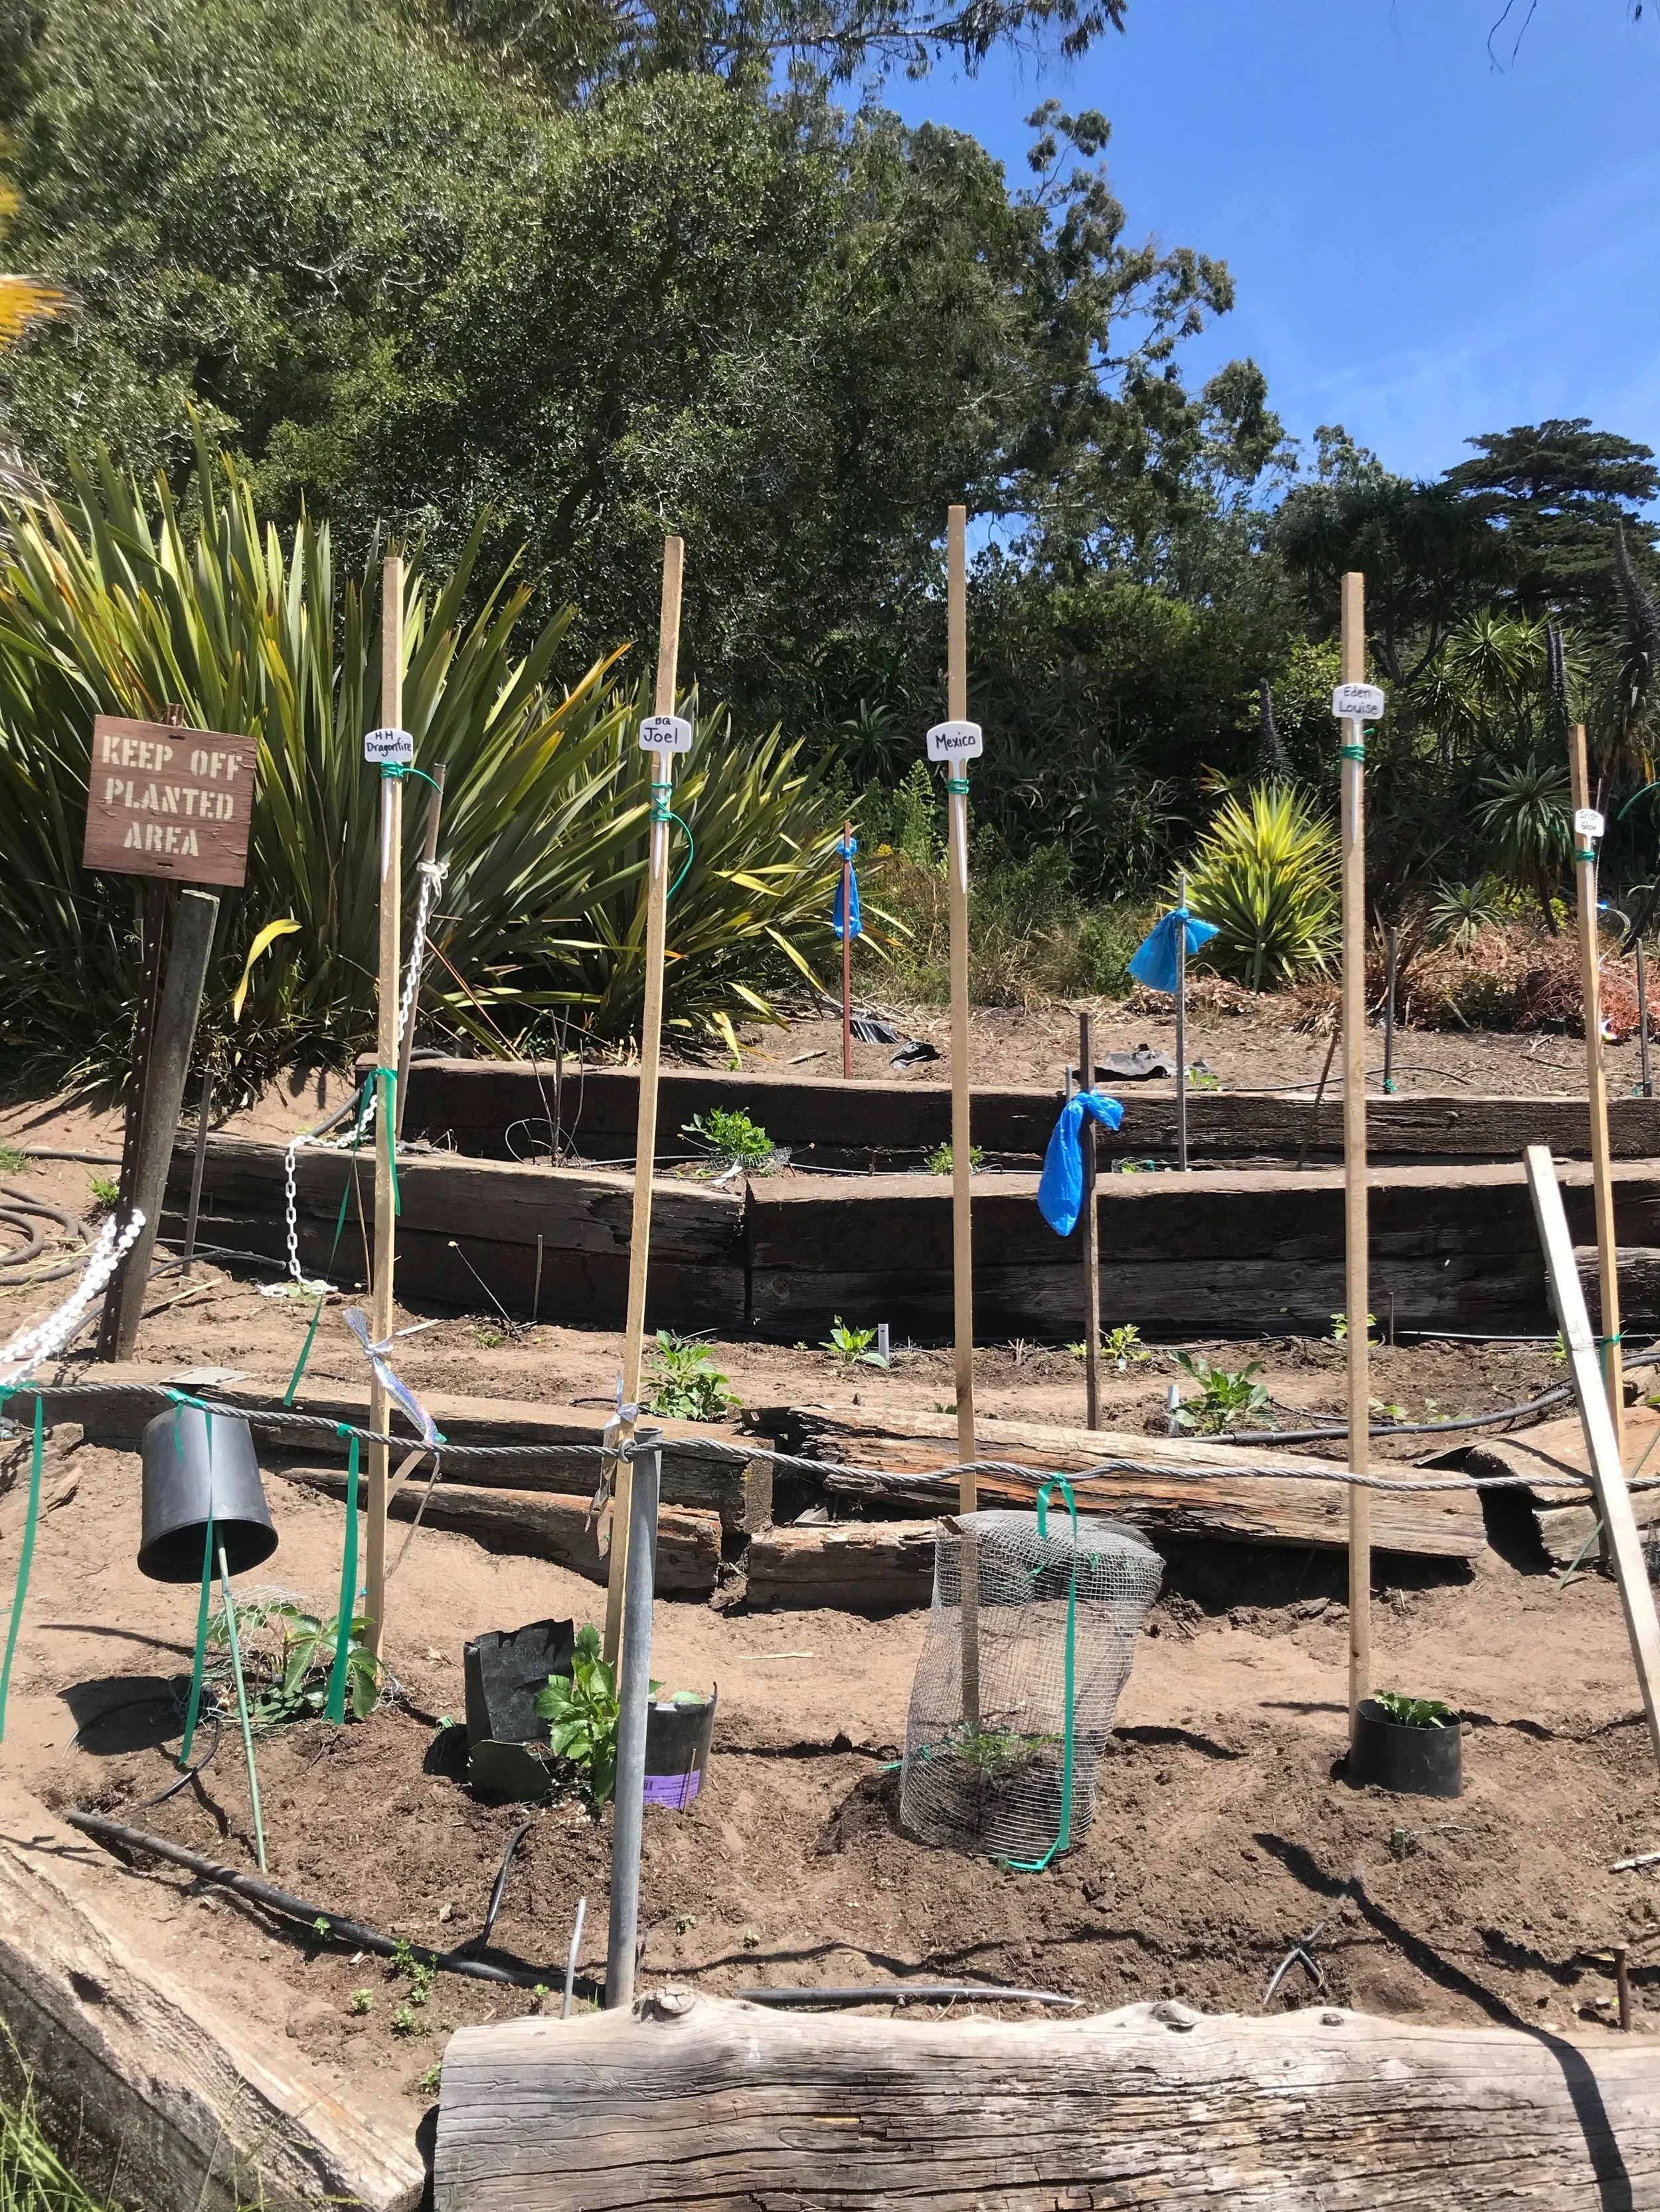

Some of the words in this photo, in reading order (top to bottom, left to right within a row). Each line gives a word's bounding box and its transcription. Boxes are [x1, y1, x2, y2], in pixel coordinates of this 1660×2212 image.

[1343, 685, 1370, 699] Eden
[1339, 700, 1378, 715] Louise
[643, 727, 678, 744] Joel
[935, 732, 976, 751] Mexico
[367, 737, 412, 757] Dragonfire
[102, 736, 173, 771] KEEP
[191, 750, 242, 781] OFF
[106, 777, 234, 821] PLANTED
[1580, 811, 1598, 821] Irish
[1582, 821, 1596, 830] Glow
[124, 821, 199, 856] AREA
